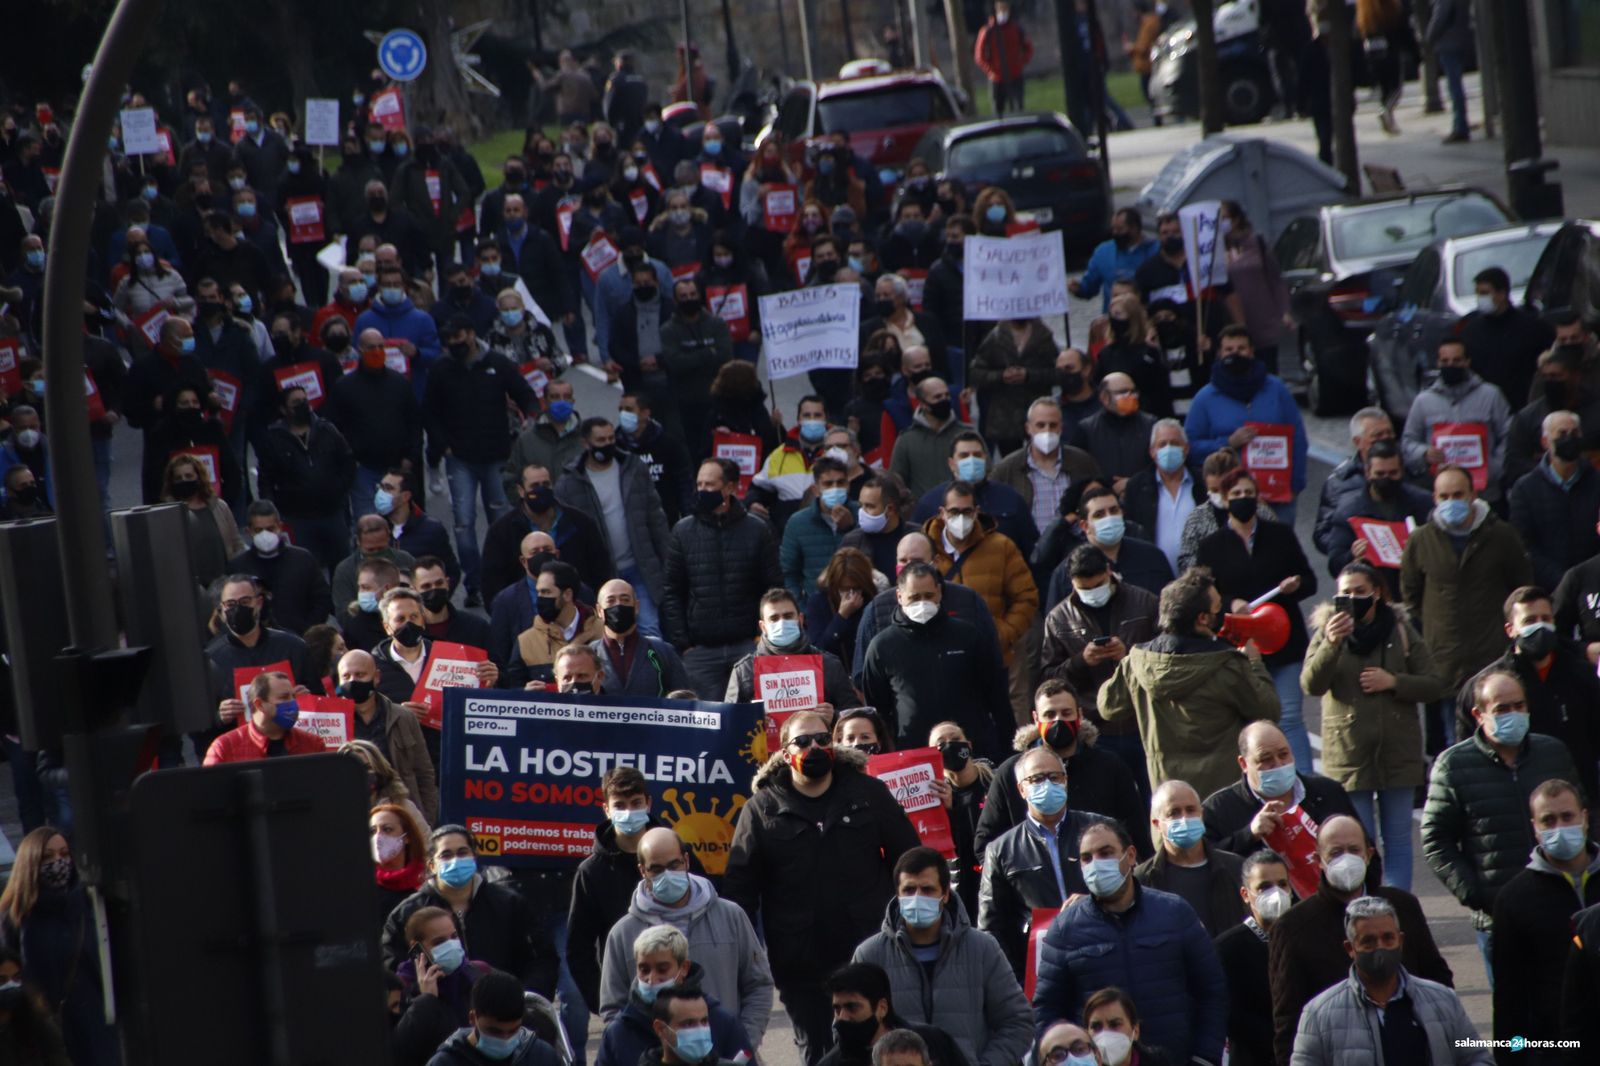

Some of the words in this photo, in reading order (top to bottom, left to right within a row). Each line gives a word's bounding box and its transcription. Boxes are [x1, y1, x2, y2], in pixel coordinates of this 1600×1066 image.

[765, 680, 778, 690] SIN
[781, 676, 810, 688] AYUDAS
[776, 685, 800, 699] Nos
[768, 695, 813, 710] Arruinan!
[468, 702, 571, 717] Comprendemos
[574, 707, 585, 718] la
[588, 710, 665, 722] emergencia
[667, 712, 717, 726] sanitaria
[467, 720, 508, 731] pero...
[465, 744, 510, 773] LA
[520, 748, 735, 784] HOSTELERÍA
[900, 770, 930, 786] AYUDAS
[464, 779, 504, 800] NO
[896, 783, 920, 799] Nos
[471, 822, 483, 832] Si
[485, 826, 501, 834] no
[503, 826, 560, 838] podemos
[504, 840, 565, 851] podremos
